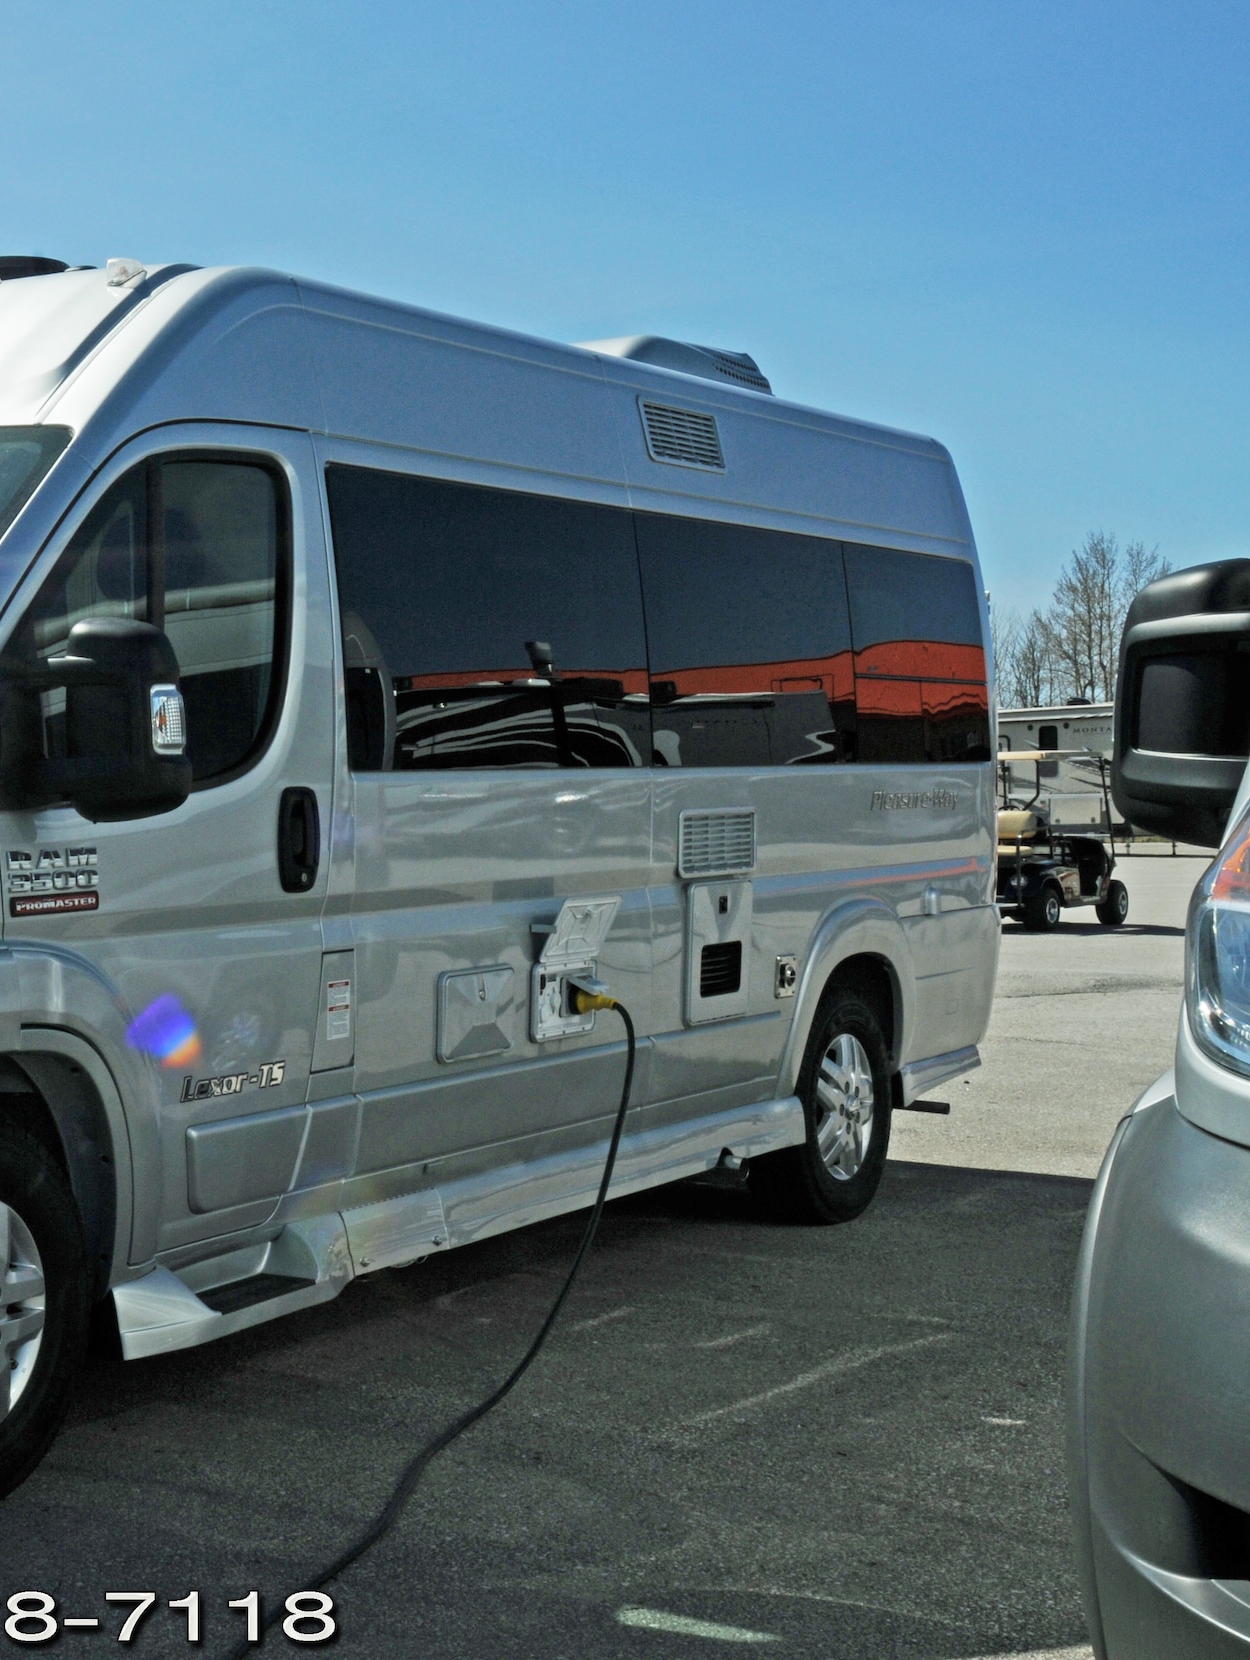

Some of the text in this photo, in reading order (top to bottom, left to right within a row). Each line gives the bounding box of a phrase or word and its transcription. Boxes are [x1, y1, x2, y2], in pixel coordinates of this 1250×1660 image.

[6, 847, 98, 871] RAM
[7, 868, 99, 893] 3500
[15, 897, 96, 911] PROMASTER
[180, 1060, 286, 1103] Lexor-TS
